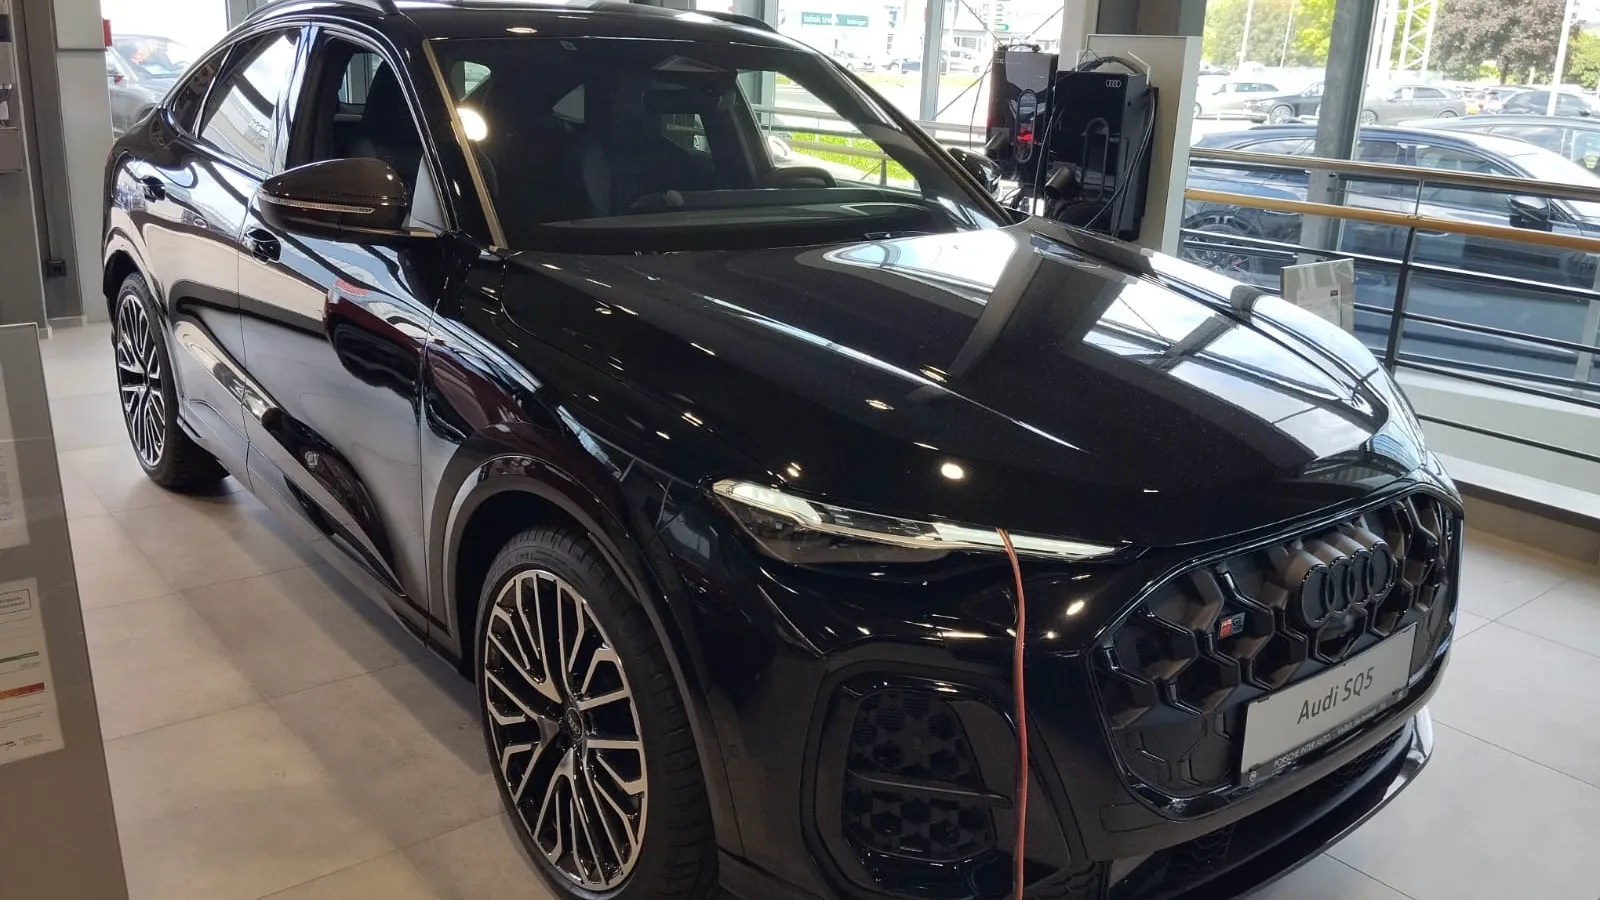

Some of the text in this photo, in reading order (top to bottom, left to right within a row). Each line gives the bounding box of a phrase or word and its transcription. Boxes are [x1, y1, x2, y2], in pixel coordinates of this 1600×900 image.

[1297, 685, 1339, 724] Audi
[1342, 666, 1374, 701] SQ5
[1273, 749, 1300, 768] PORSCHE
